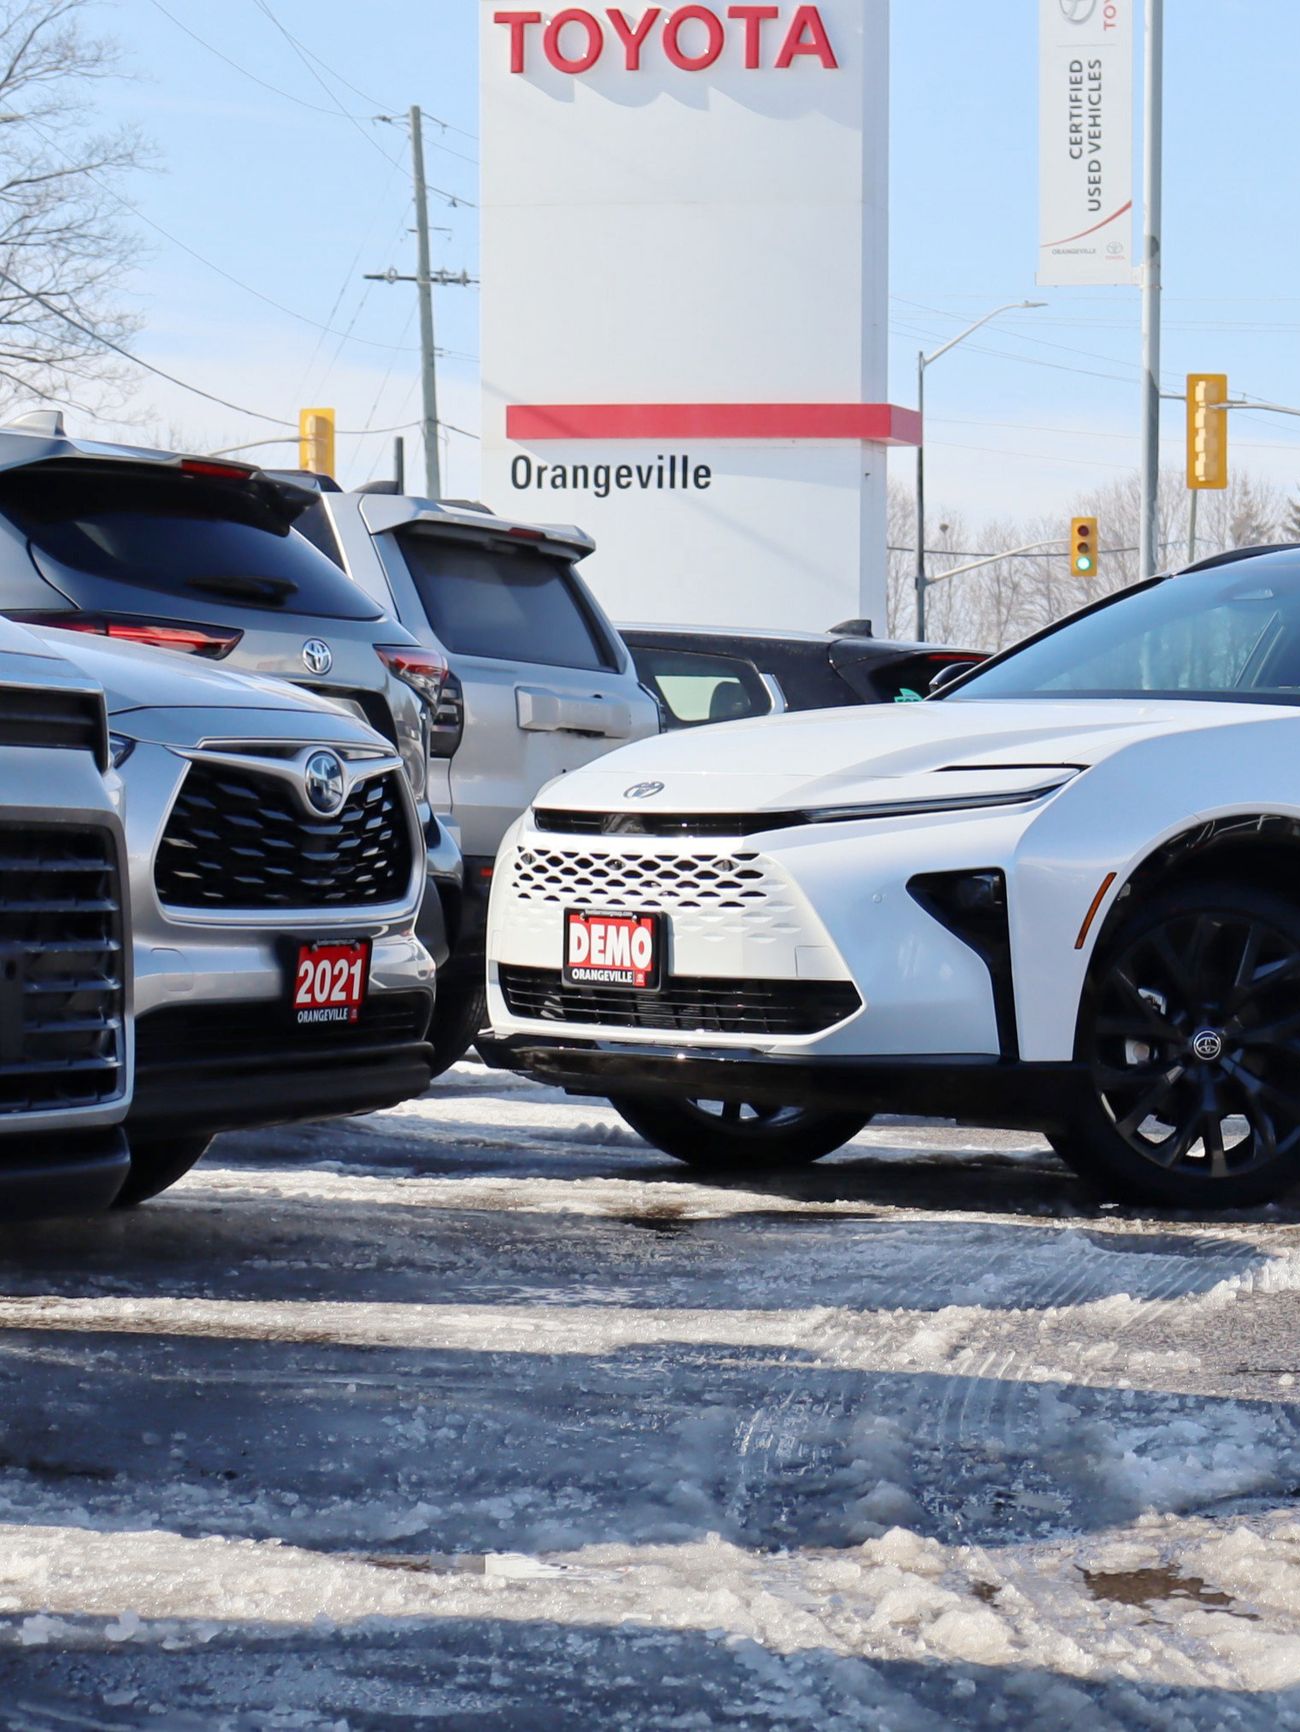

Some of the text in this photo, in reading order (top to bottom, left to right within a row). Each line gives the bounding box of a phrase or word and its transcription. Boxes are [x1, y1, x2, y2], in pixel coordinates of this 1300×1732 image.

[494, 5, 839, 74] TOYOTA
[1069, 59, 1083, 160] CERTIFIED
[1088, 58, 1102, 212] USED VEHICLES
[510, 454, 712, 498] Orangeville
[569, 922, 652, 969] DEMO
[296, 958, 362, 1004] 2021
[572, 968, 633, 983] ORANGEVILLE
[297, 1007, 348, 1024] ORANGEVILLE
